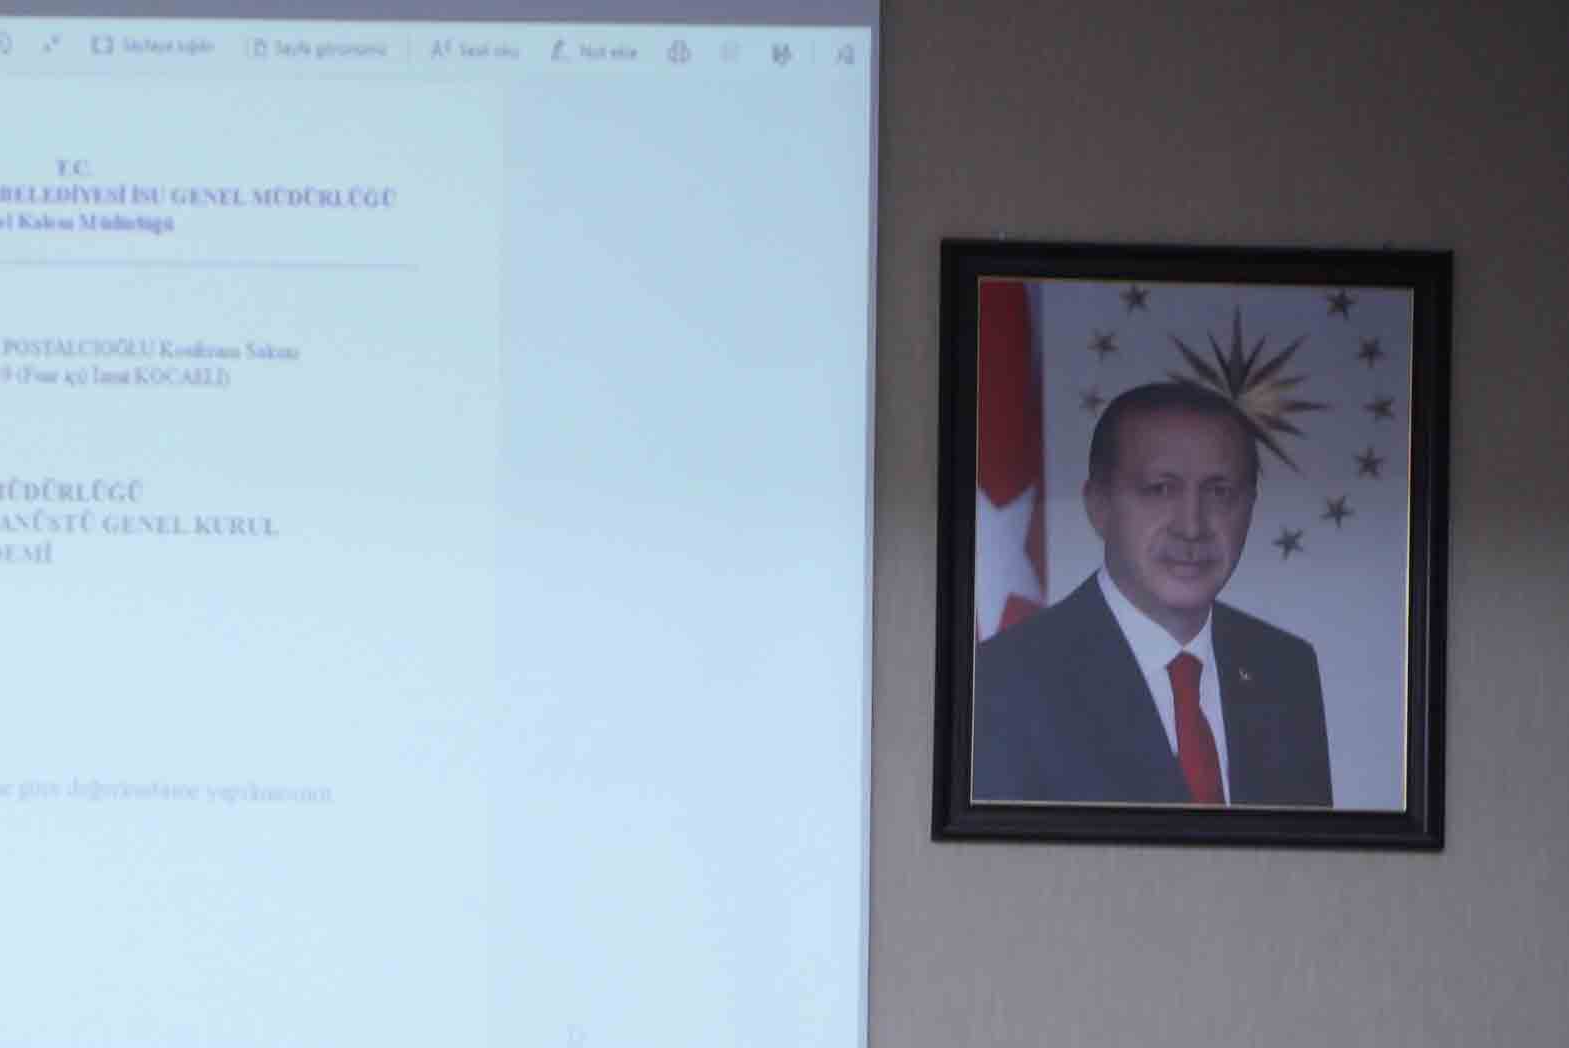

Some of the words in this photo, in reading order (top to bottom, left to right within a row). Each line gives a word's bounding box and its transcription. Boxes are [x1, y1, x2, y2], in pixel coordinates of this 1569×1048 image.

[171, 184, 246, 207] GENEL
[103, 512, 188, 536] GENEL
[193, 512, 280, 538] KURUL
